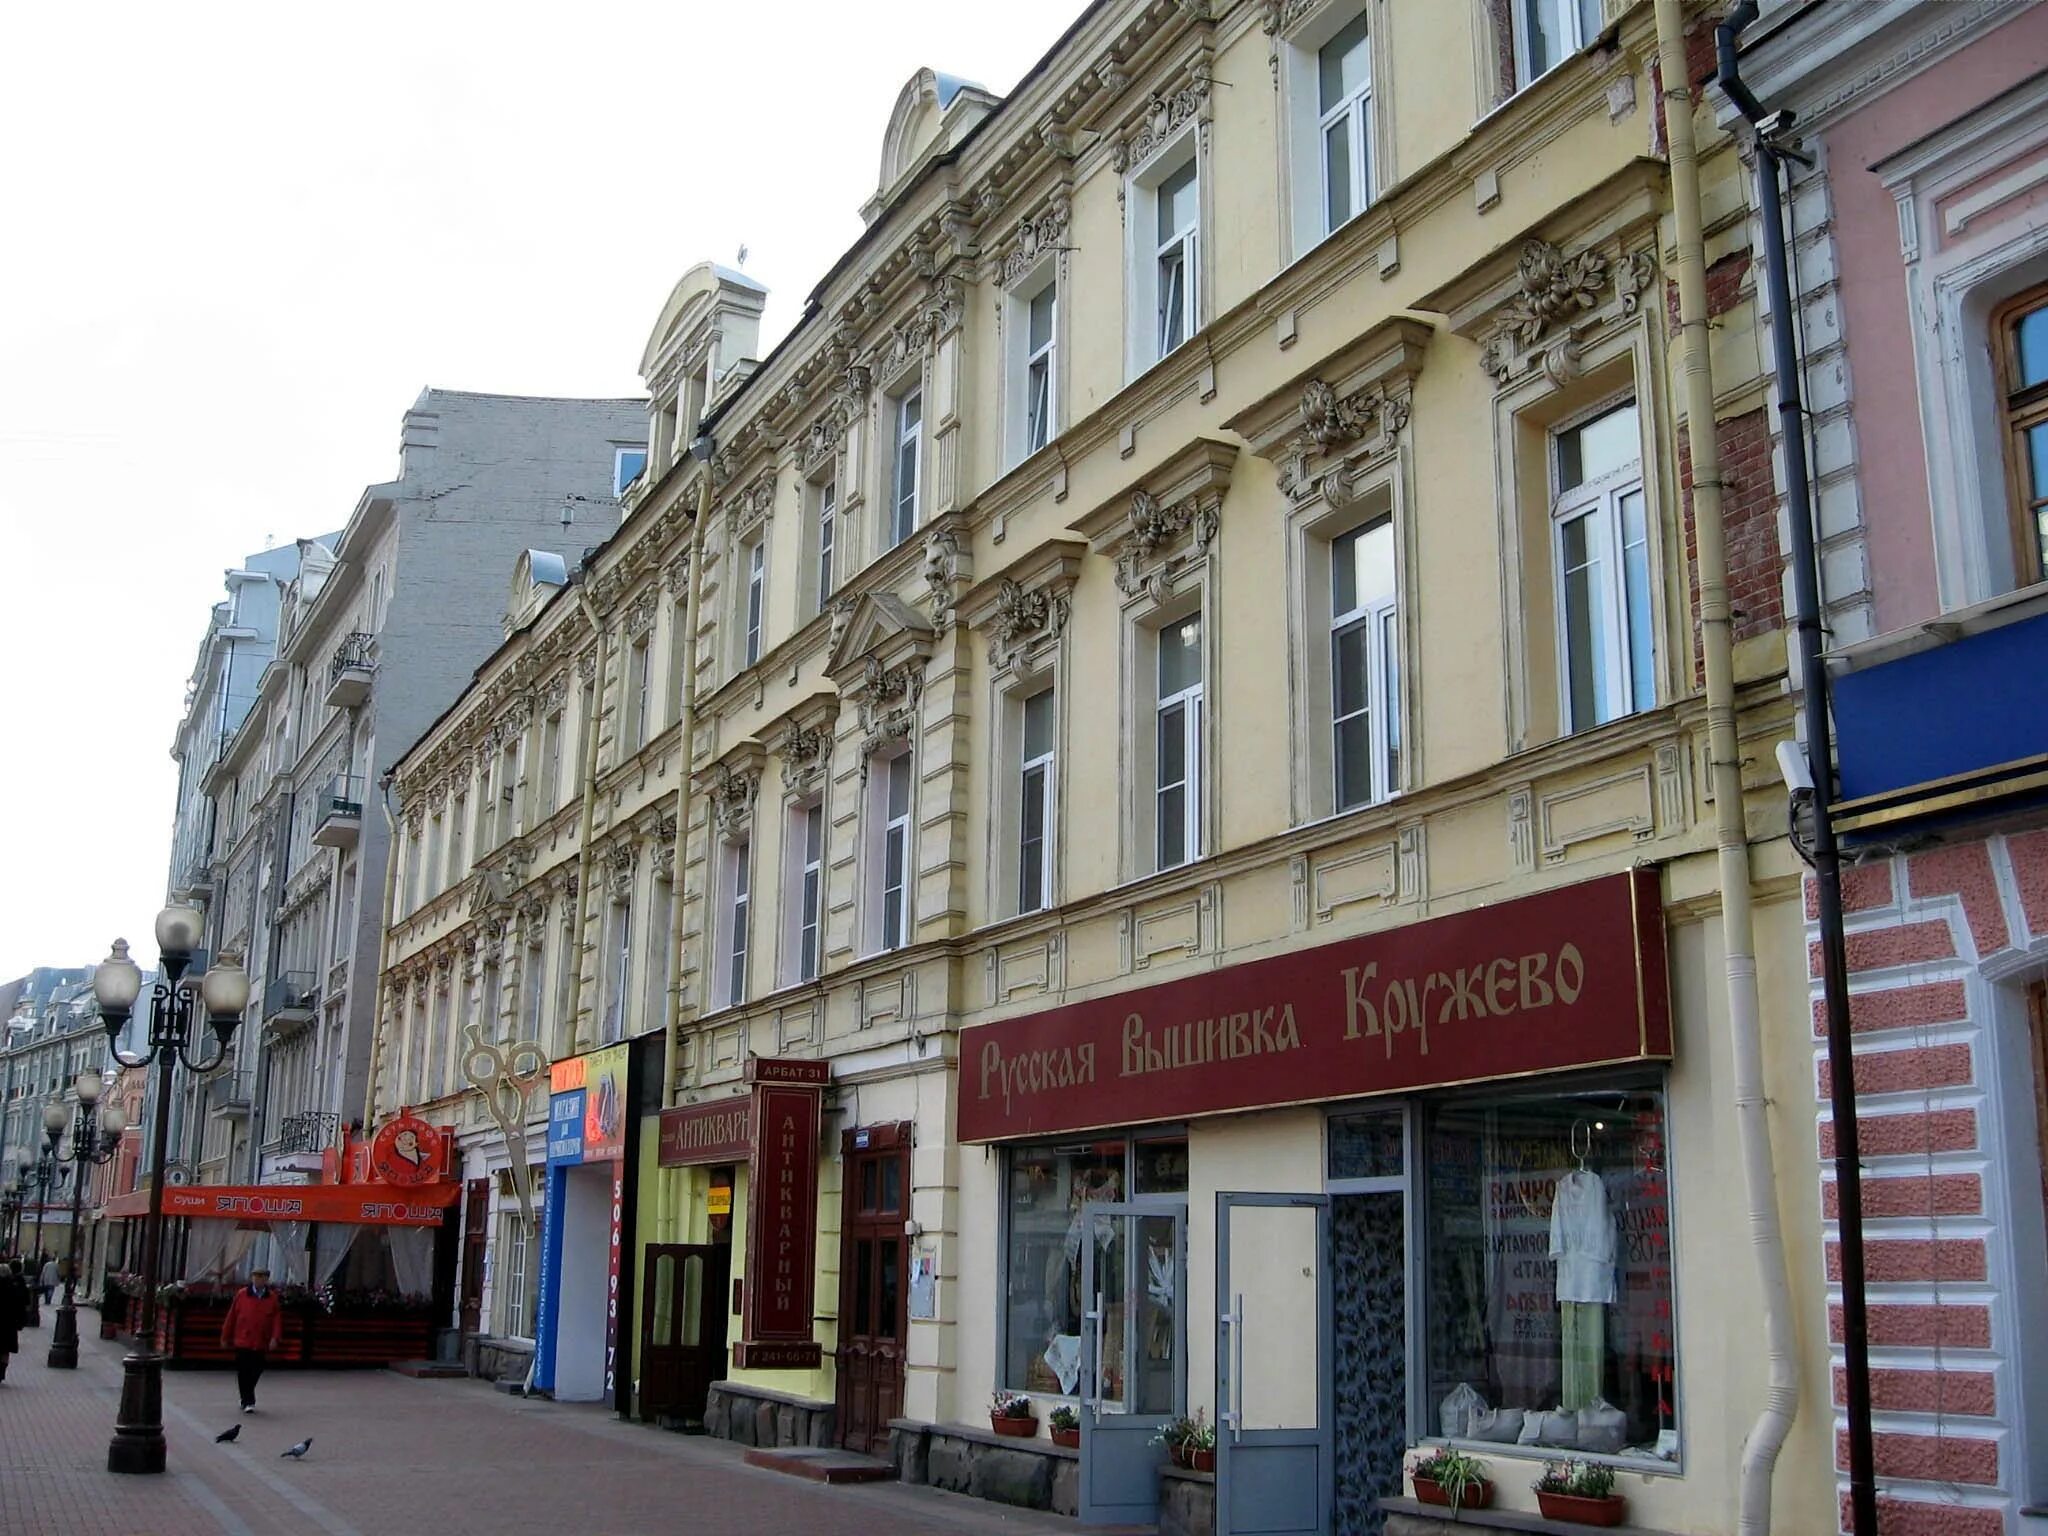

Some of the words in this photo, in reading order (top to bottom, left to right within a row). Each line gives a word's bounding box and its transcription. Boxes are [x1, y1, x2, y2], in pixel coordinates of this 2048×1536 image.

[764, 1066, 803, 1078] АРБАТ
[808, 1069, 820, 1078] 31
[776, 1116, 794, 1310] АНТИКВАРНЫЙ
